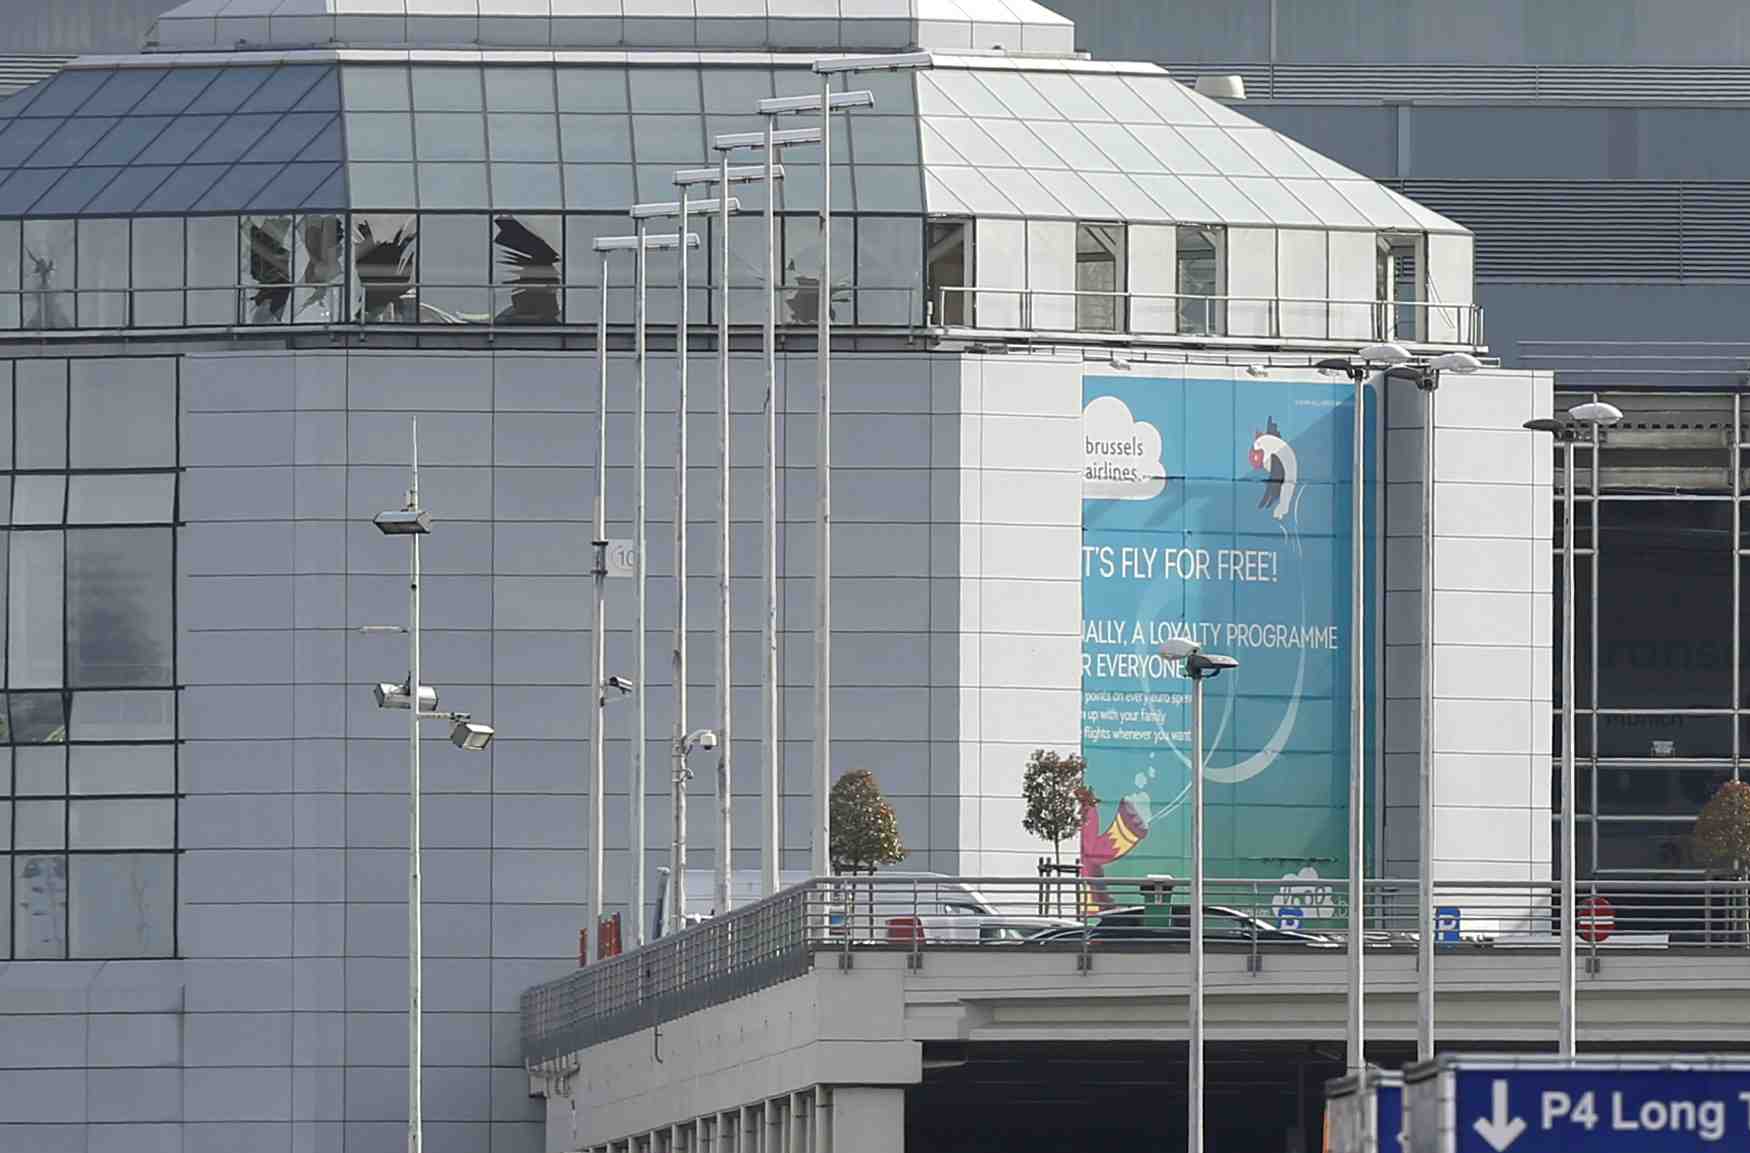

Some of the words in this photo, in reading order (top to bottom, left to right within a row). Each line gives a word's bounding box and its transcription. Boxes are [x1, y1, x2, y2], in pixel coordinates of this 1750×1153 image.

[1086, 436, 1143, 456] brussels
[1085, 462, 1138, 482] airlines
[1121, 547, 1157, 579] FLY
[1164, 548, 1210, 580] FOR
[1218, 550, 1278, 582] FREE!
[1132, 621, 1145, 645] A
[1149, 621, 1222, 647] LOYALTY
[1226, 623, 1338, 650] PROGRAMME
[1541, 1091, 1599, 1131] P4
[1611, 1091, 1726, 1141] Long
